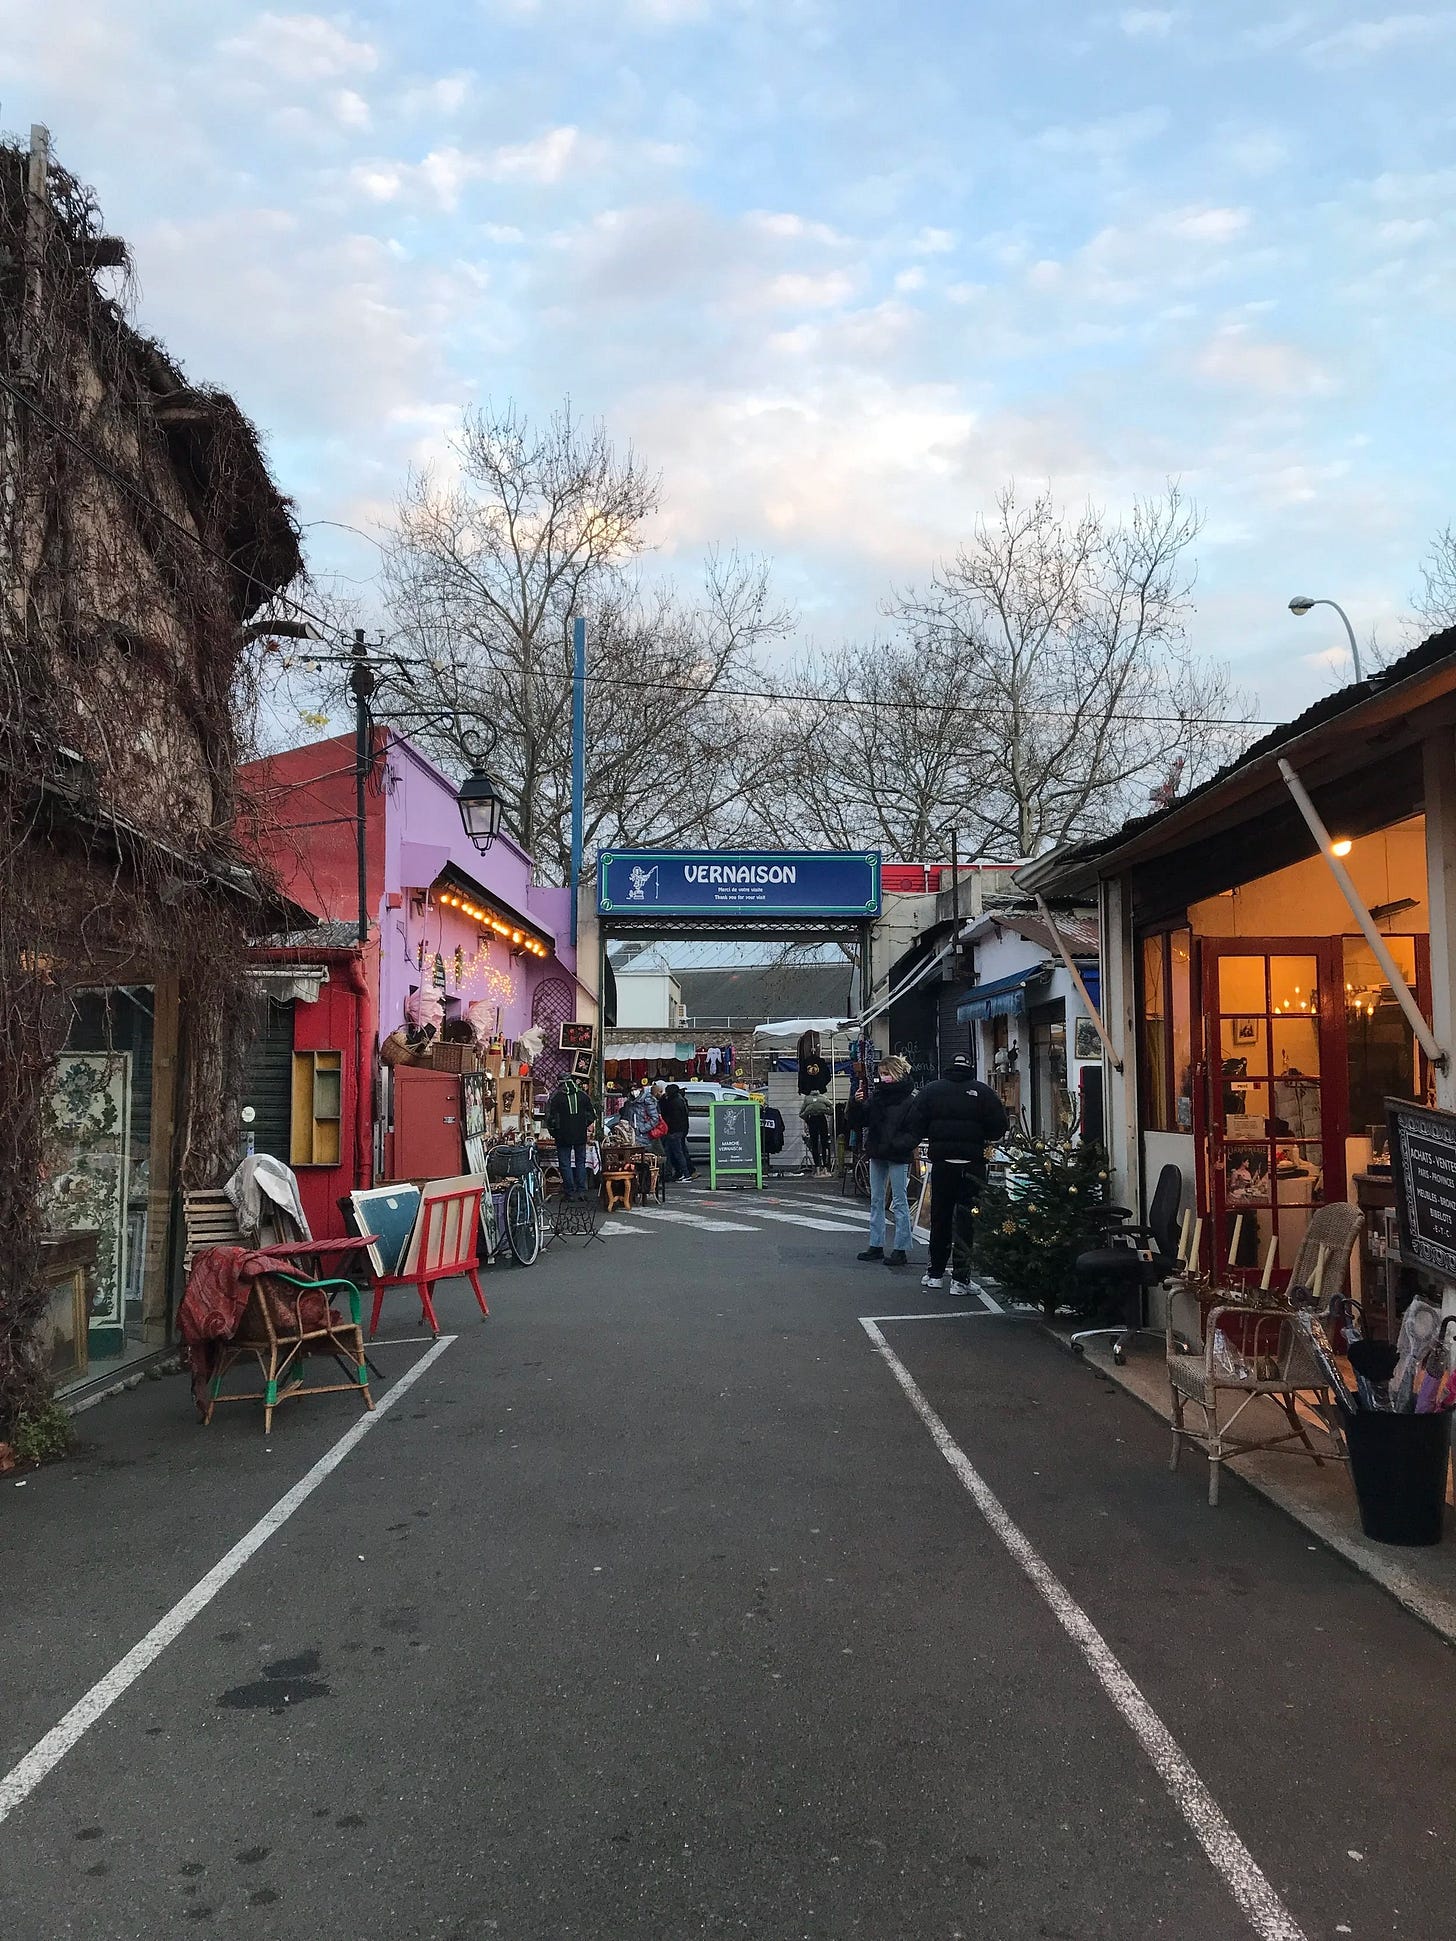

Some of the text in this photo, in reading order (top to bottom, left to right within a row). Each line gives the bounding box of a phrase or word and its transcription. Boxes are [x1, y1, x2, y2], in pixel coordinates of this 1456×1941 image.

[684, 865, 796, 884] VERNAISON
[1410, 1148, 1432, 1164] ACHATS
[1417, 1167, 1430, 1179] PARIS
[1416, 1188, 1438, 1203] MEUBLES
[1429, 1207, 1453, 1225] BIBELOTS
